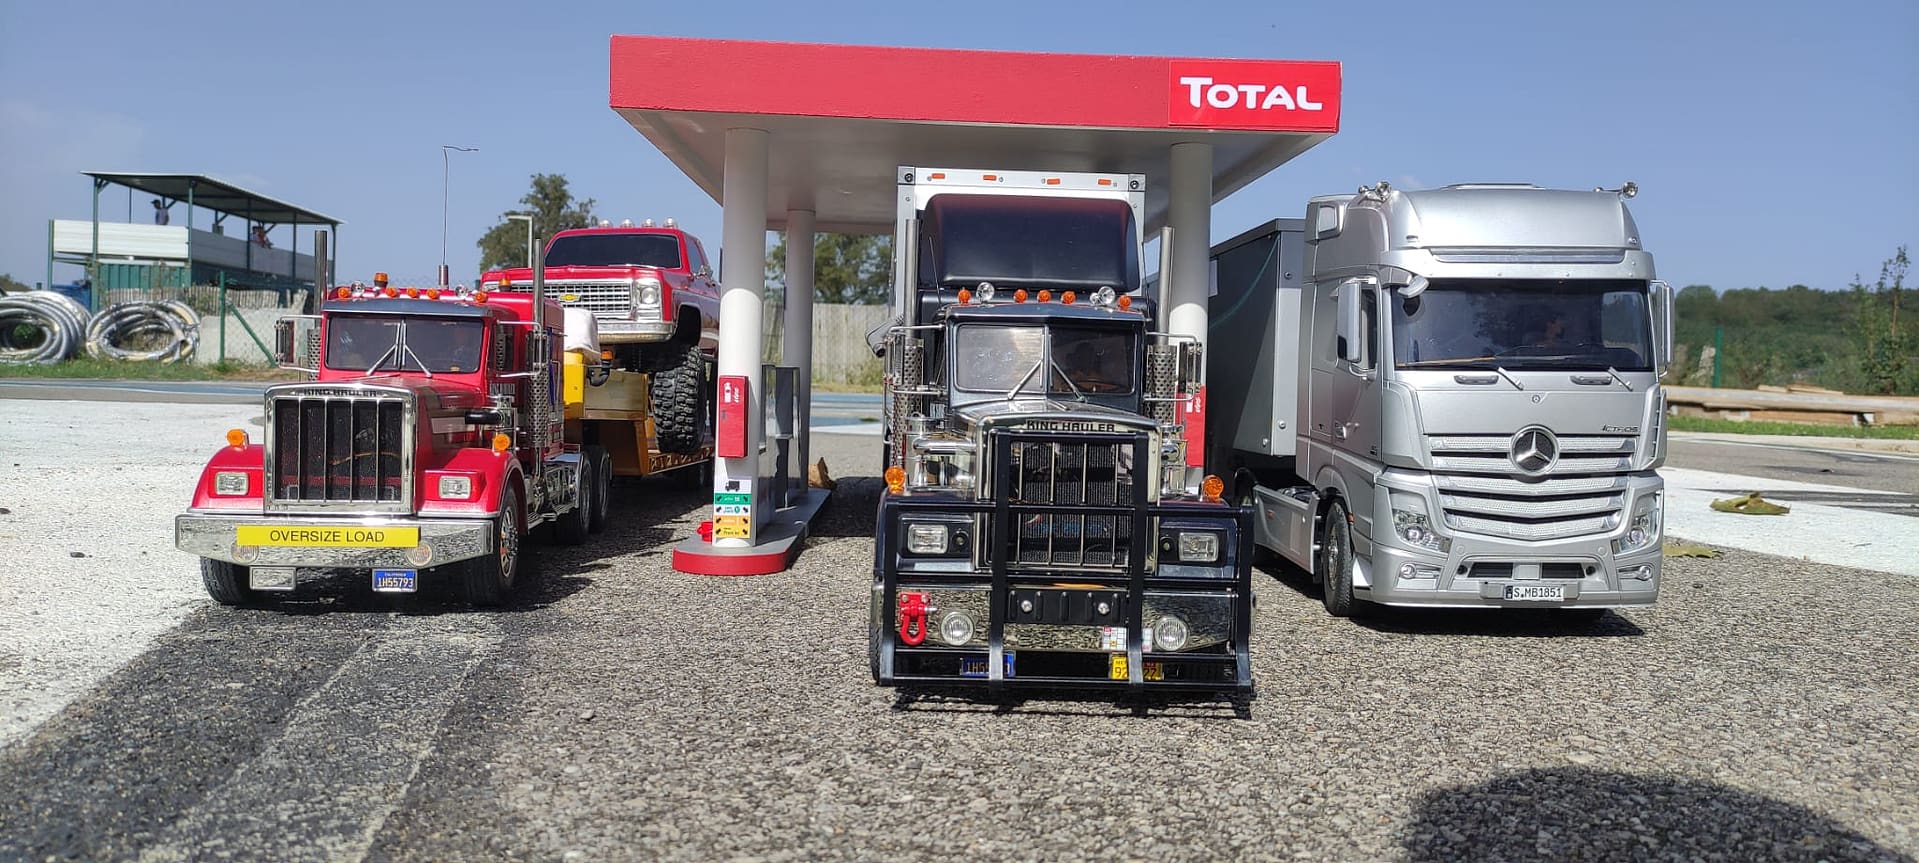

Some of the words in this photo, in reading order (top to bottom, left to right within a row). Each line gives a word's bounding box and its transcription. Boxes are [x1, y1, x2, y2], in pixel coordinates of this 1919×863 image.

[1180, 77, 1322, 110] TOTAL
[1026, 420, 1058, 431] KING
[1062, 422, 1115, 432] HAULER
[270, 530, 341, 542] OVERSIZE
[346, 531, 385, 542] LOAD
[377, 577, 414, 588] 1H55793
